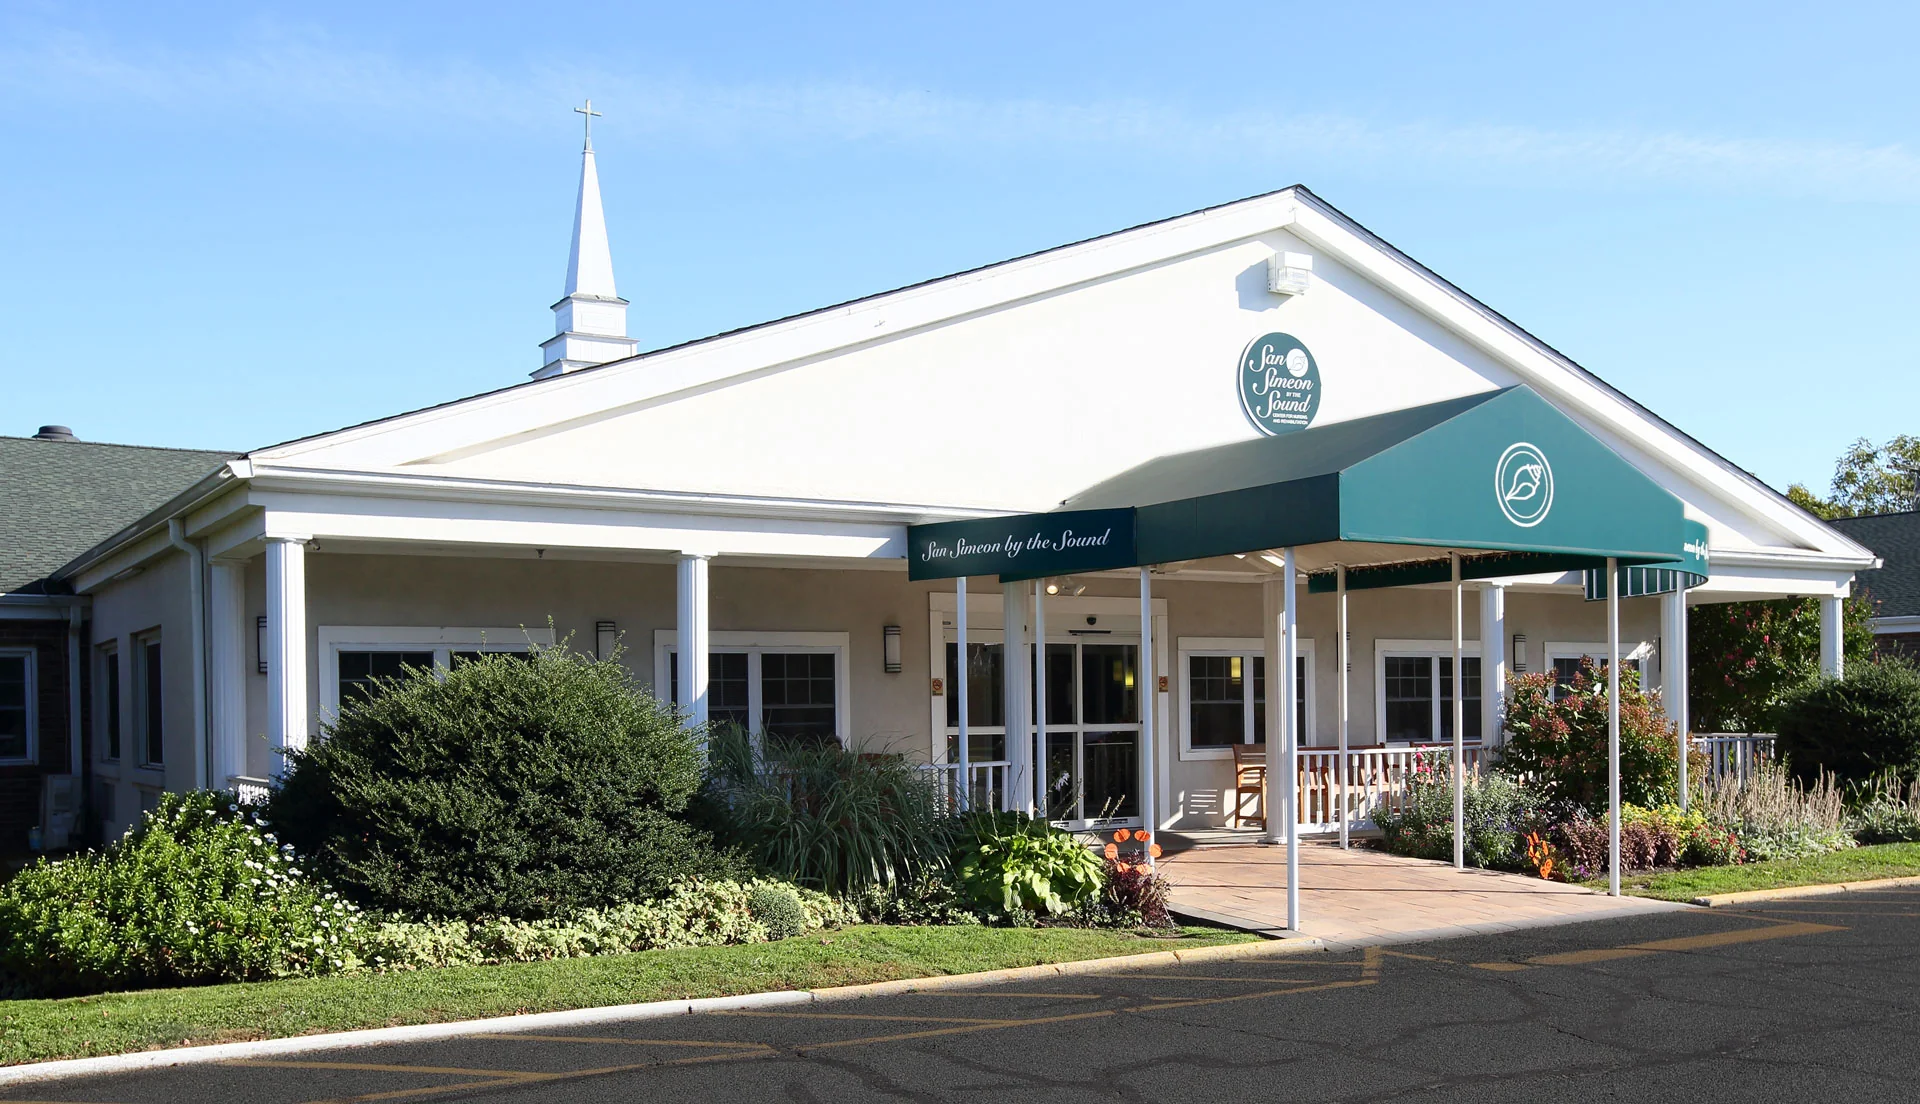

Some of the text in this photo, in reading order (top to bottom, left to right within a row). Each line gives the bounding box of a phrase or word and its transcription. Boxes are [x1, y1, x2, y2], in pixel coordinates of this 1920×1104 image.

[1249, 344, 1286, 372] San
[1252, 367, 1314, 395] Simeon
[1256, 390, 1311, 418] Sound
[922, 528, 1111, 562] San Simeon by the Sound
